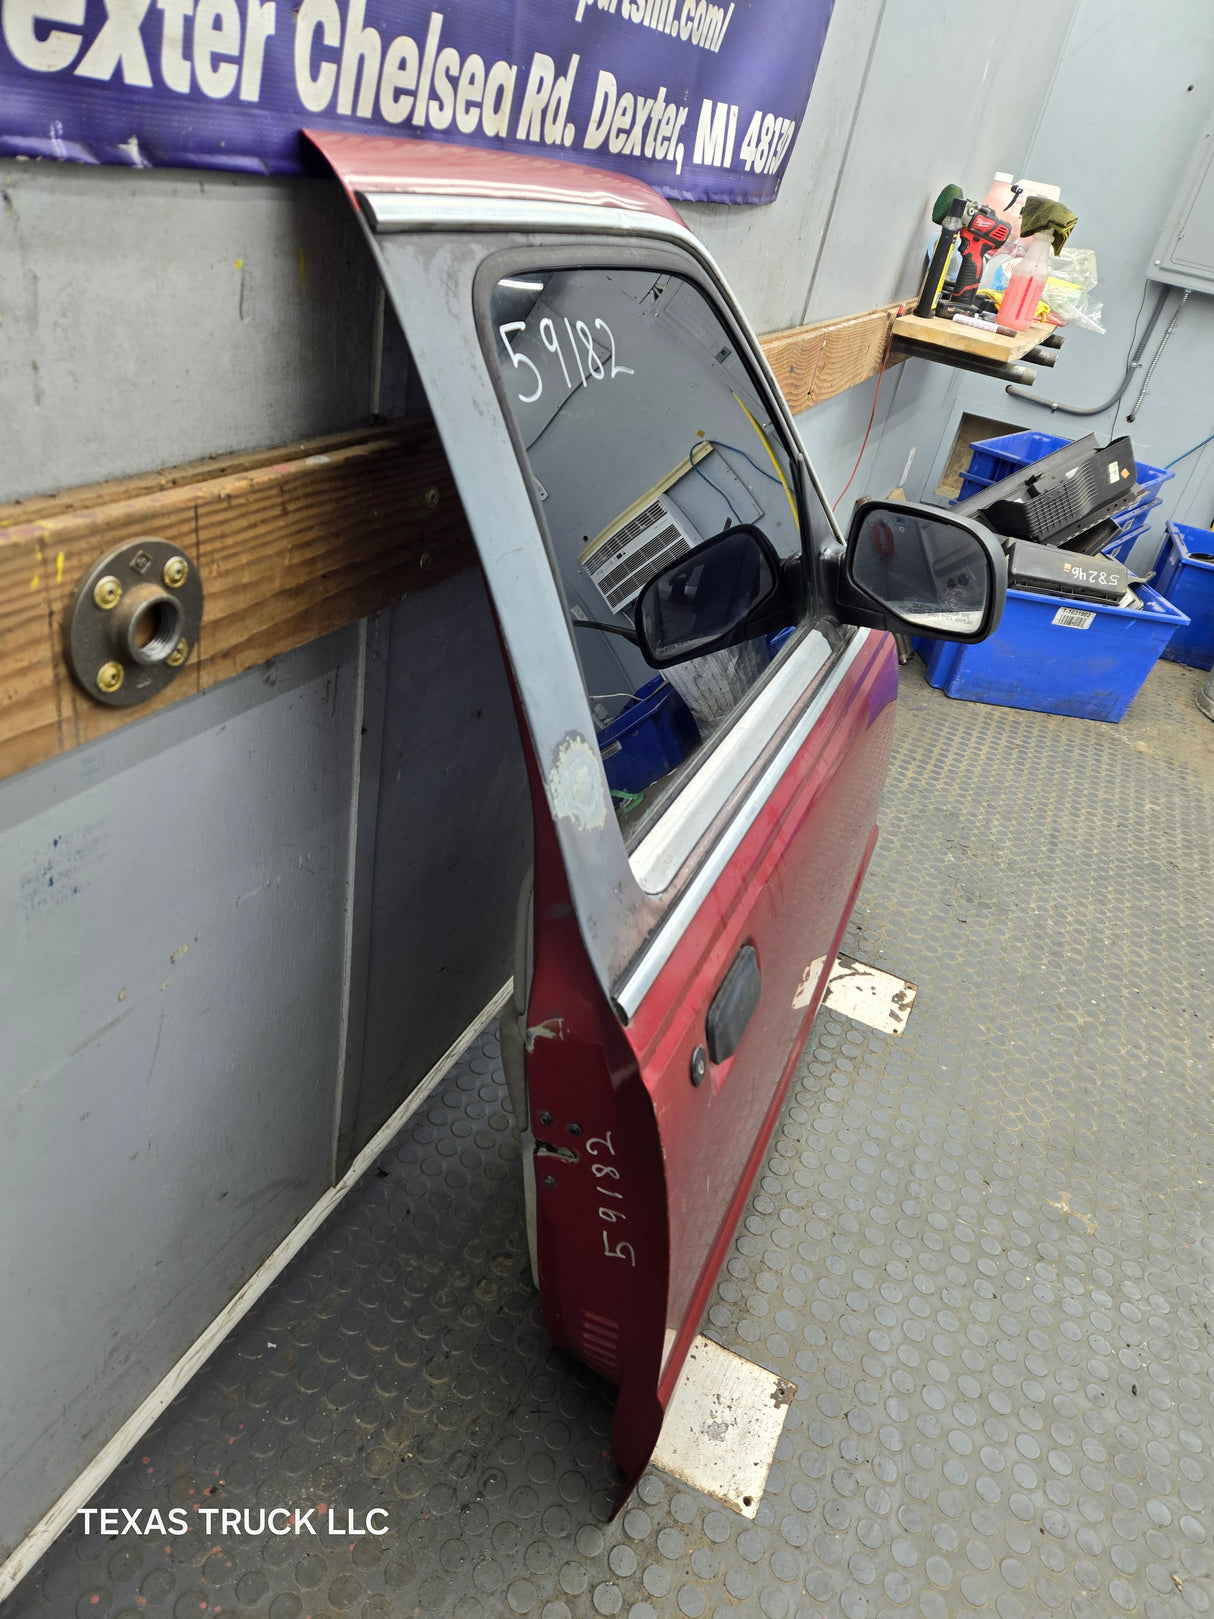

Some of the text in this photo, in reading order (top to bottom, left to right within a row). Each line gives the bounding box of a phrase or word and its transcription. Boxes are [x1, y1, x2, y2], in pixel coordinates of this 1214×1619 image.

[294, 0, 518, 138] Chelsea
[516, 52, 581, 148] Rd.
[583, 69, 689, 175] Dexter,
[693, 99, 739, 168] MI
[740, 110, 796, 175] 48130
[499, 317, 635, 403] 59182
[1071, 566, 1120, 586] 58246
[586, 1131, 636, 1267] 59182
